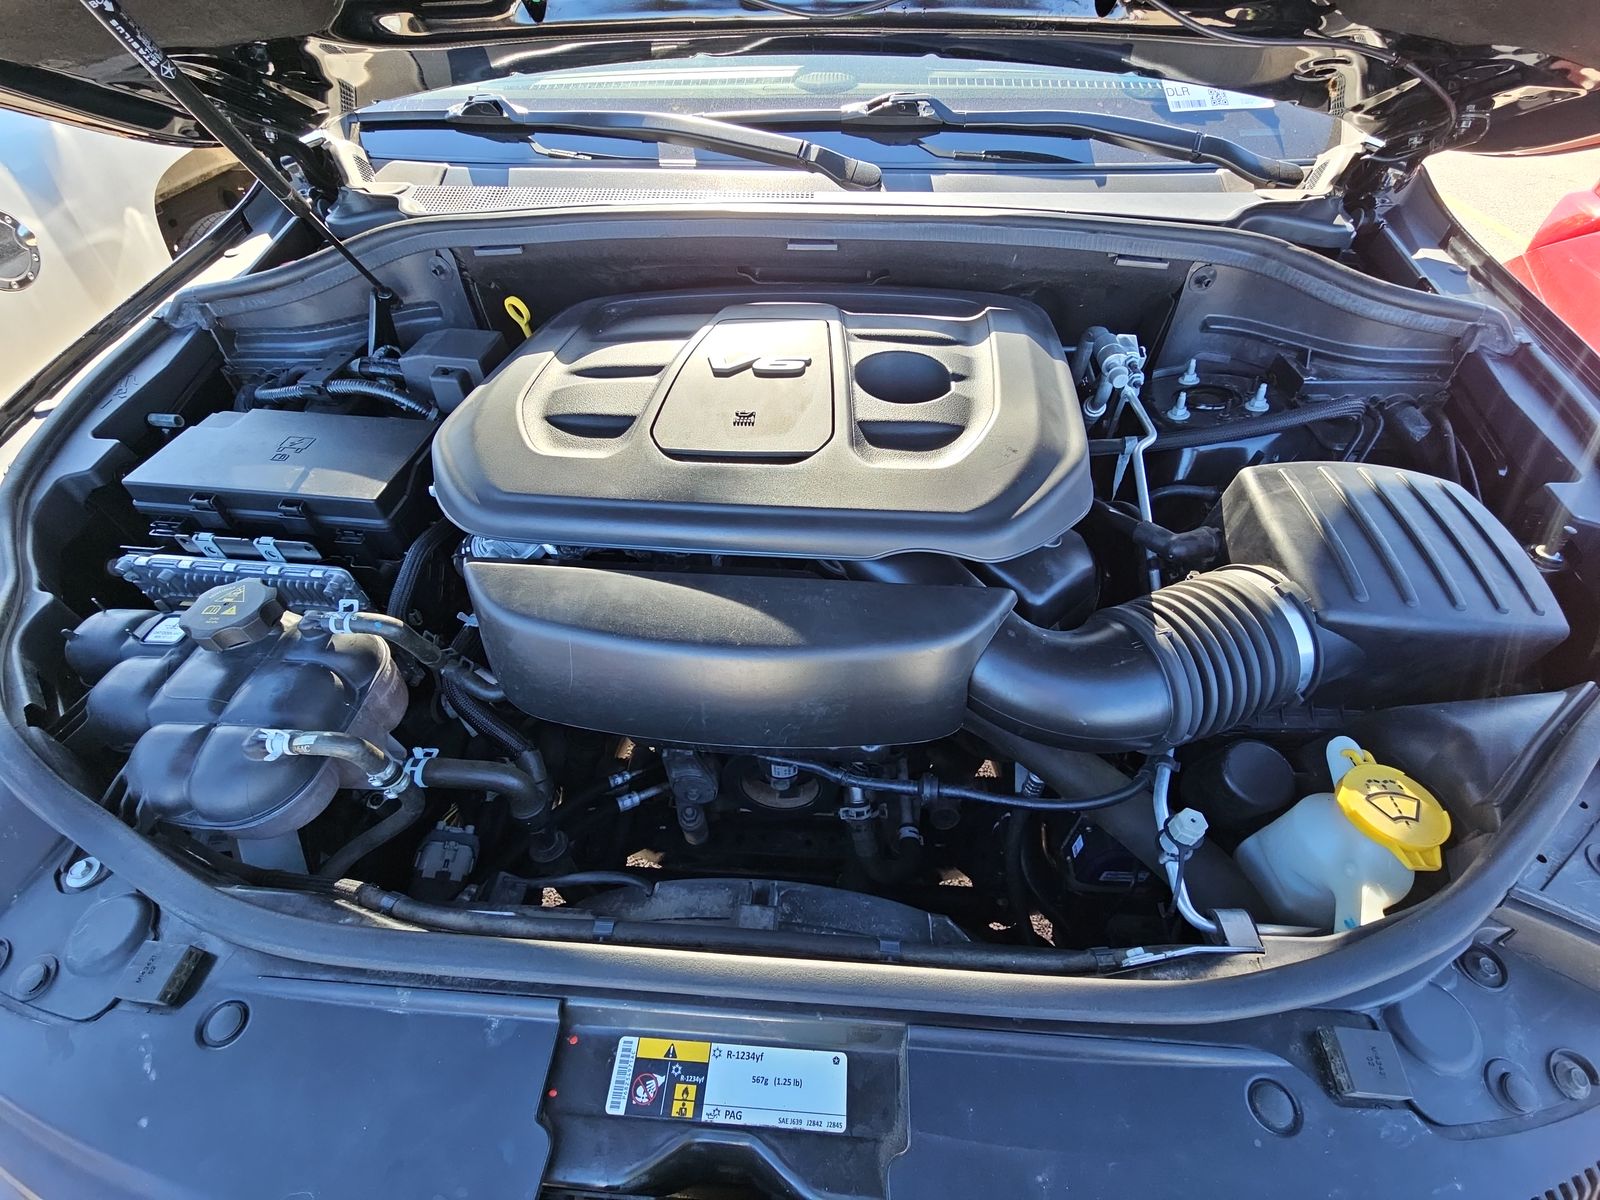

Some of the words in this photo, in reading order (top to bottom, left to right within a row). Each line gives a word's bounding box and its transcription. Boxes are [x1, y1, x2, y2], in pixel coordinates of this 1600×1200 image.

[109, 18, 158, 67] STABILUS
[1166, 87, 1191, 97] DLR
[707, 356, 812, 378] V6
[726, 1050, 764, 1063] R-1234yf
[680, 1074, 705, 1083] R-1234yf
[751, 1075, 769, 1086] 567g
[773, 1076, 792, 1087] (1.25
[793, 1077, 803, 1088] lb)
[724, 1109, 743, 1121] PAG
[778, 1117, 789, 1125] SAE
[789, 1117, 803, 1126] J639
[806, 1120, 823, 1128] J2842
[826, 1121, 843, 1129] J2845
